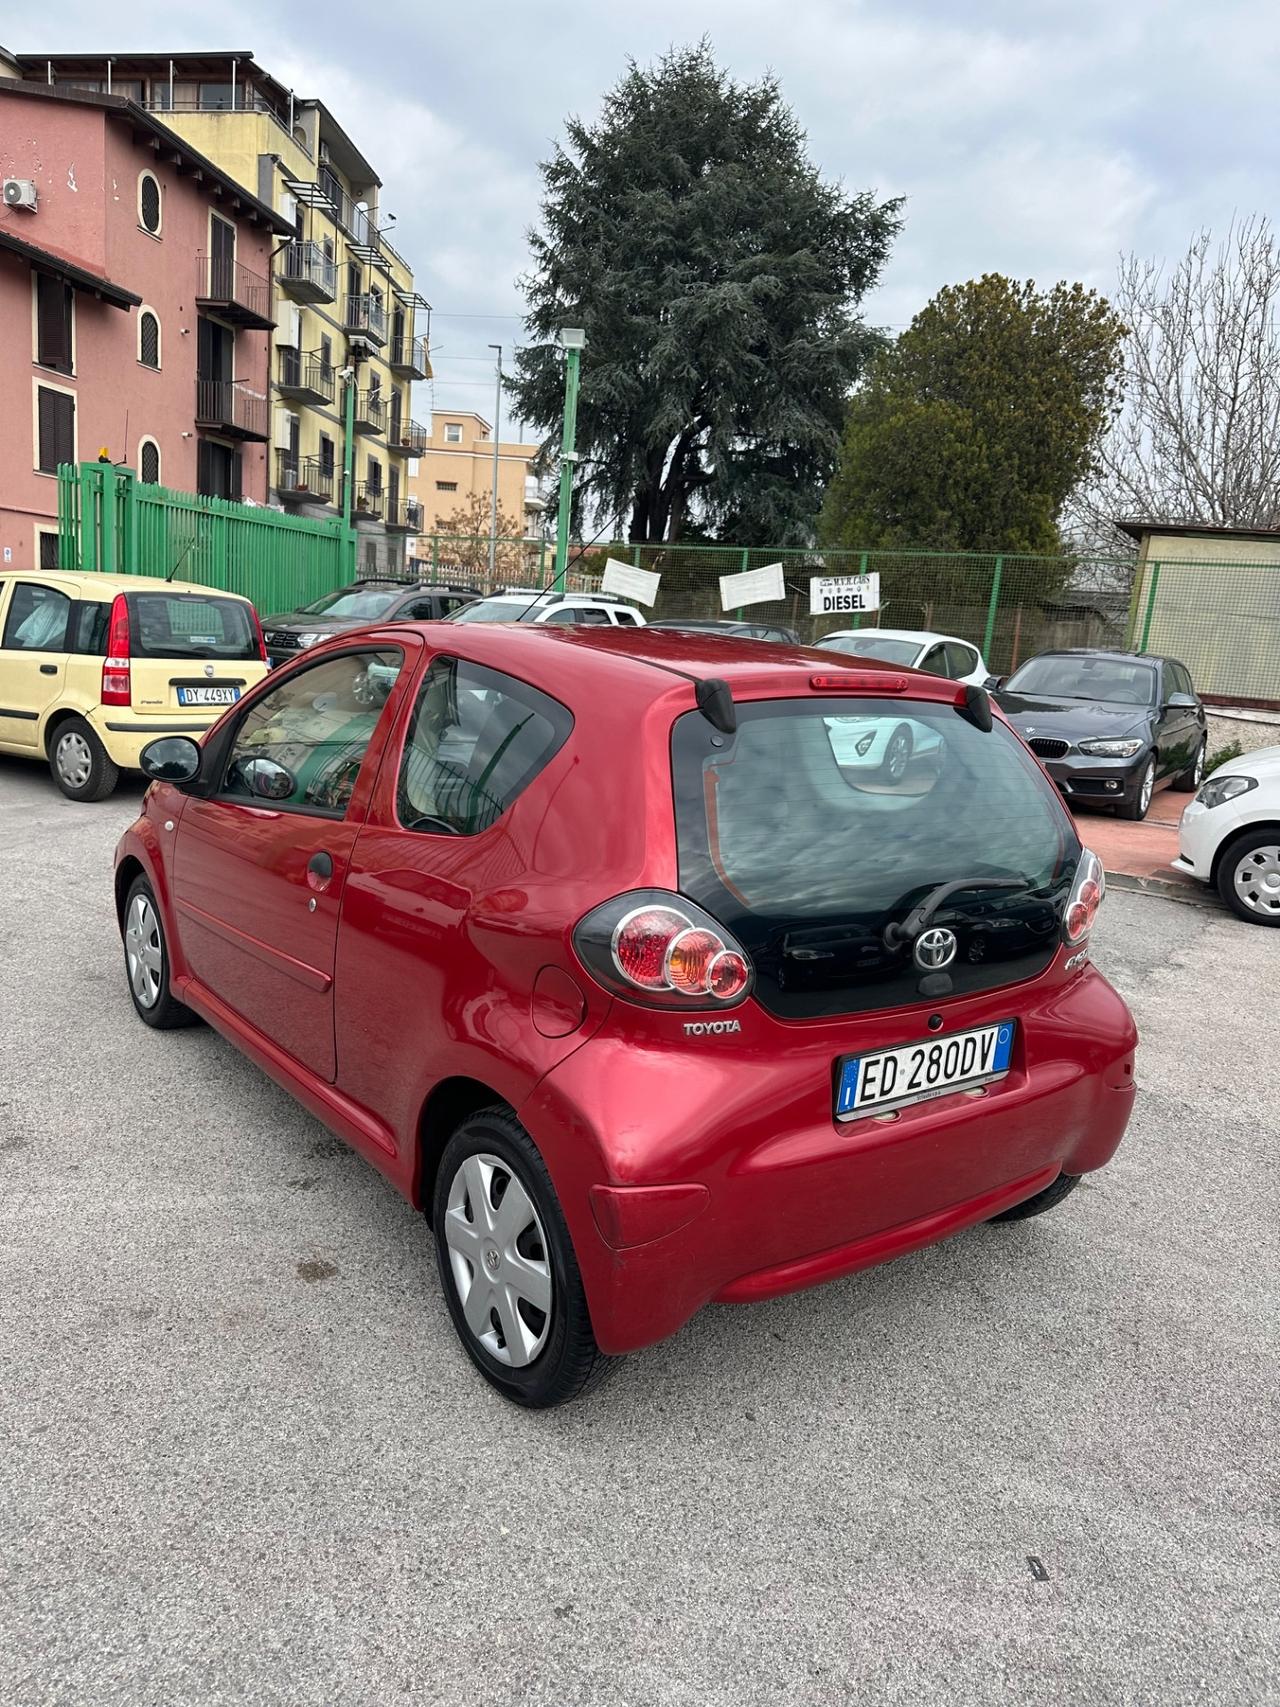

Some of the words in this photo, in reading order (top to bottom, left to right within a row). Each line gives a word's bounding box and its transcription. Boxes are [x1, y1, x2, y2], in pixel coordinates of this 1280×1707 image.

[824, 594, 866, 611] DIESEL
[186, 689, 198, 702] DY
[204, 688, 233, 702] 449XY
[684, 1019, 741, 1036] TOYOTA
[860, 1055, 898, 1102] ED
[907, 1032, 994, 1090] 280DV
